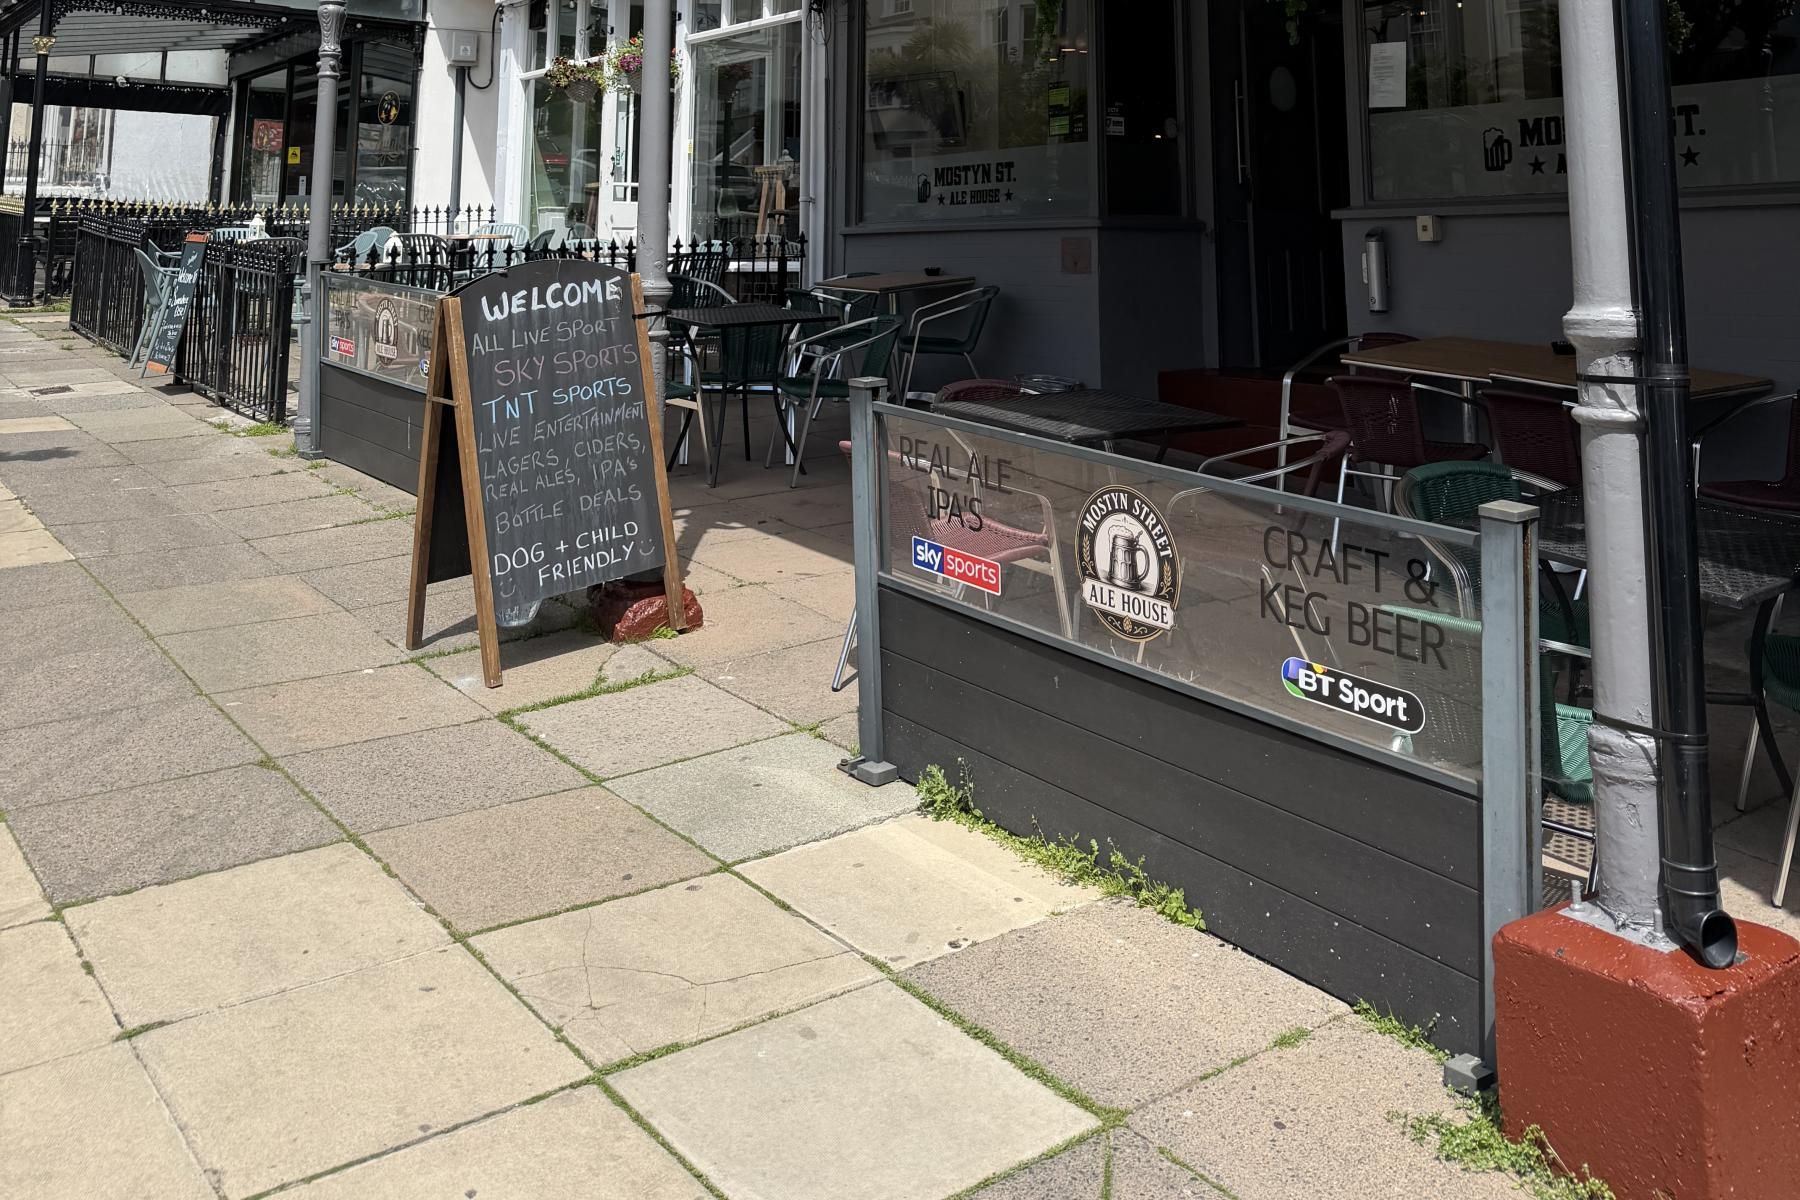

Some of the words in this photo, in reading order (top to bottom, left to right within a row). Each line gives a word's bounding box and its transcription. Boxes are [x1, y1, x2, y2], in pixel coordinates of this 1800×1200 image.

[934, 163, 992, 187] MOSTYN
[995, 161, 1017, 183] ST.
[949, 191, 967, 206] ALE
[969, 188, 1001, 205] HOUSE
[481, 276, 622, 322] WELCOME
[472, 333, 504, 357] ALL
[512, 327, 550, 349] LIVE
[556, 317, 620, 342] SPORT
[494, 355, 545, 387] SKY
[553, 344, 638, 374] SPORTS
[482, 390, 538, 424] TNT
[552, 377, 632, 405] SPORTS
[479, 426, 521, 453] LIVE
[533, 401, 645, 441] ENTERTAINMENT
[900, 435, 958, 481] REAL
[966, 452, 1012, 495] ALE
[485, 480, 529, 502] REAL
[580, 484, 642, 512] DEALS
[927, 485, 983, 532] IPA'S
[1083, 492, 1128, 533] MOSTYN
[1132, 499, 1173, 559] STREET
[494, 542, 545, 577] DOG
[555, 540, 569, 553] +
[575, 521, 639, 550] CHILD
[538, 541, 635, 587] FRIENDLY
[916, 542, 942, 571] sky
[946, 554, 997, 584] sports
[1263, 526, 1390, 593] CRAFT
[1404, 558, 1440, 608] &
[1089, 584, 1116, 609] ALE
[1121, 593, 1169, 625] HOUSE
[1260, 578, 1330, 636] KEG
[1347, 601, 1448, 670] BEER
[1299, 668, 1335, 697] BT
[1338, 678, 1409, 722] Sport
